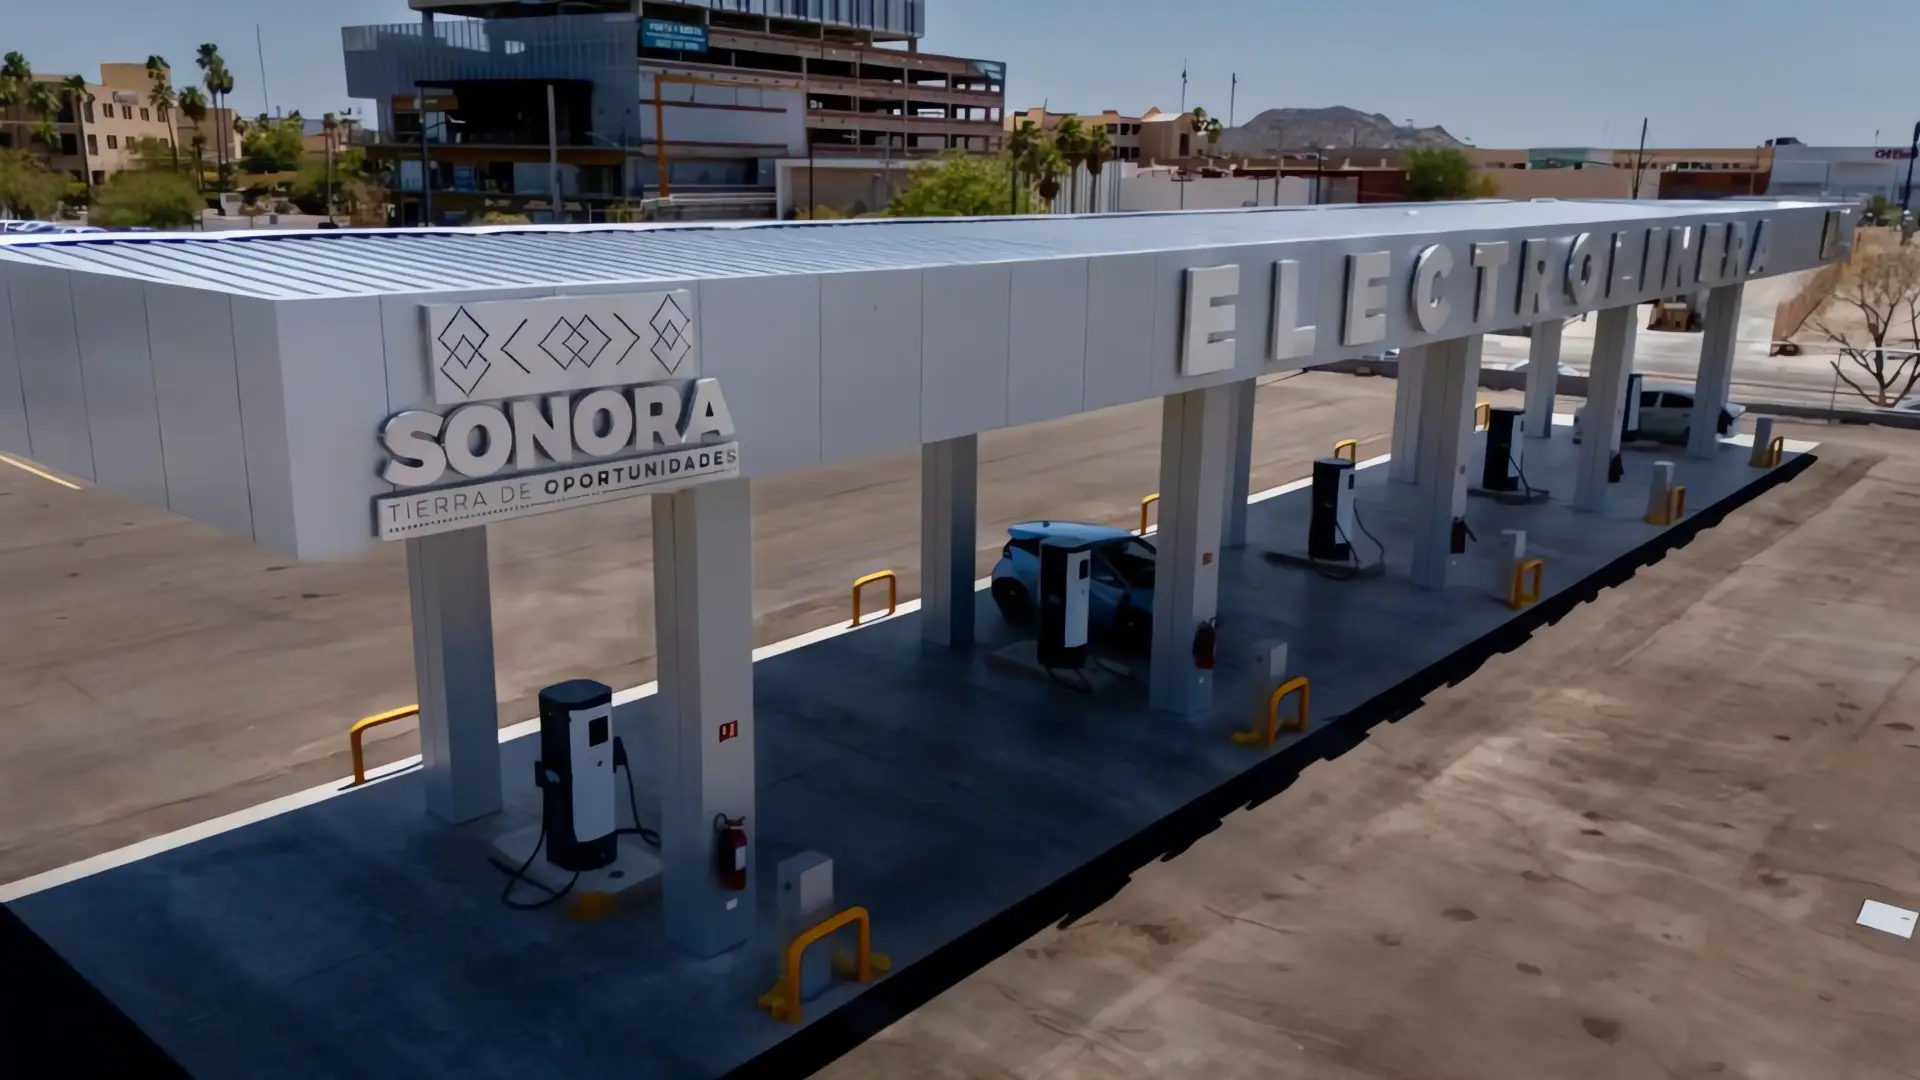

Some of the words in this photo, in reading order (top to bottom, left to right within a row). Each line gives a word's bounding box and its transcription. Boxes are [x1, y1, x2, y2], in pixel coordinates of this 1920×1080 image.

[379, 377, 736, 488] SONORA
[387, 490, 488, 523] TIERRA
[501, 482, 532, 504] DE
[544, 448, 738, 495] OPORTUNIDADES
